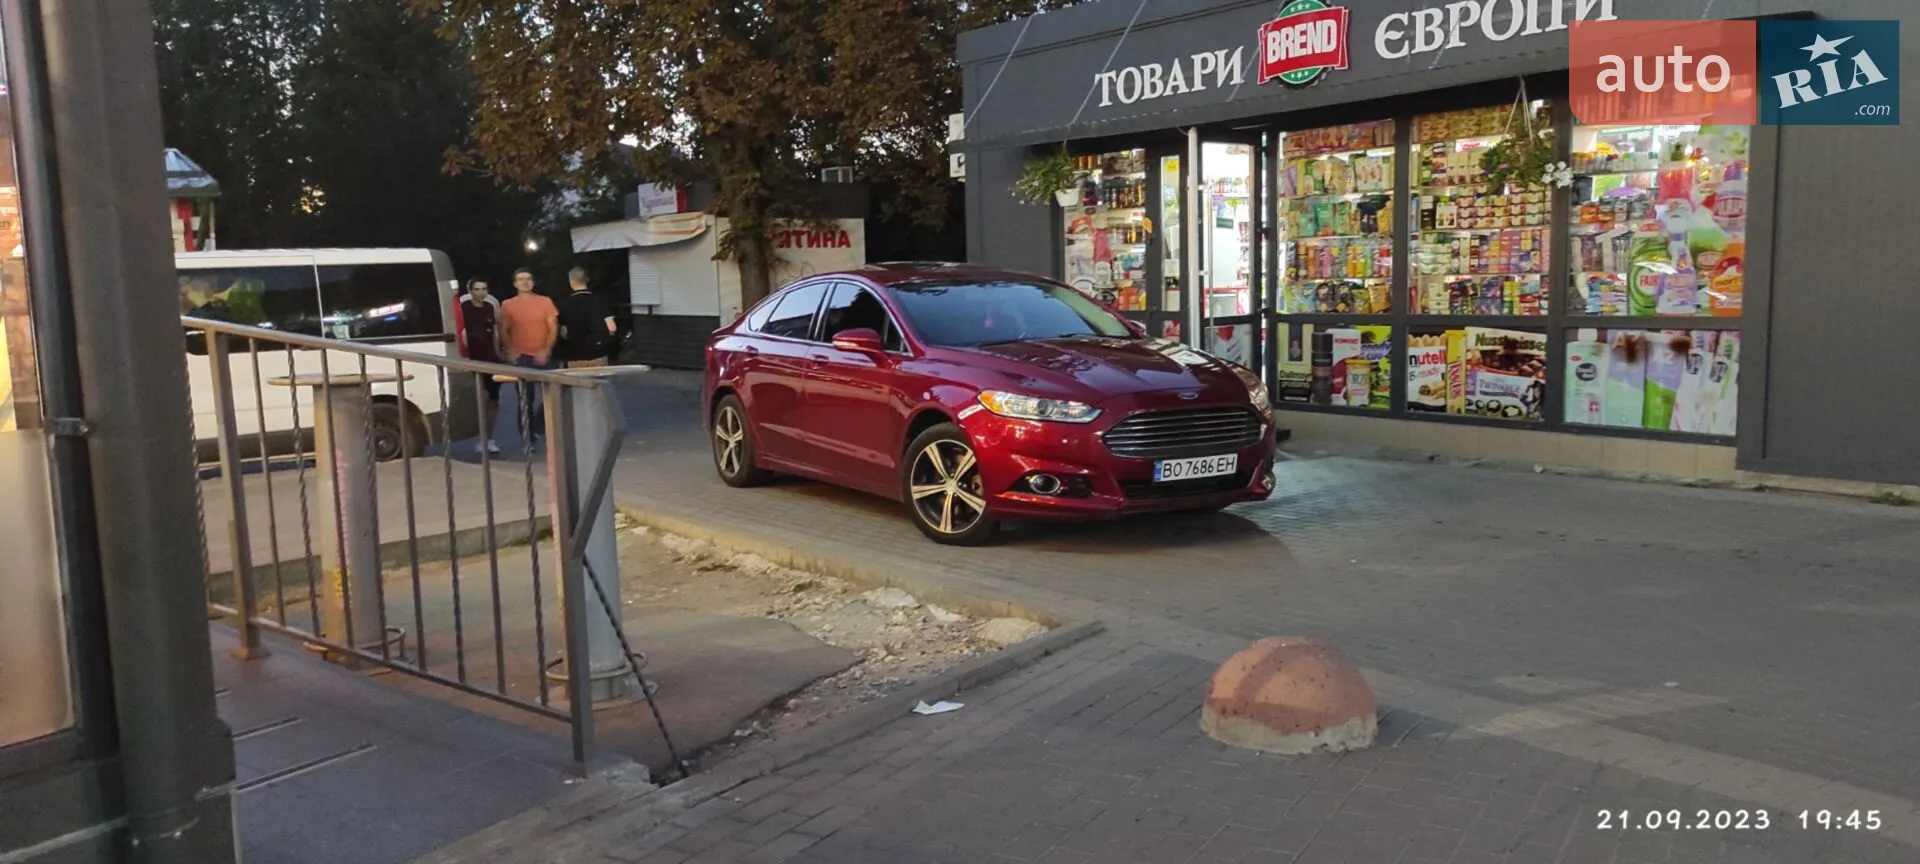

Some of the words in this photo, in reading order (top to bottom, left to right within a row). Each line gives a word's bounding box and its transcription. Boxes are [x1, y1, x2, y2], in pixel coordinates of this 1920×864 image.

[1266, 19, 1338, 65] BREND
[1374, 0, 1618, 59] ЄВРОПИ
[1095, 45, 1244, 107] ТОВАРИ
[1163, 463, 1182, 478] BO
[1185, 460, 1214, 476] 7686
[1217, 457, 1235, 472] EH
